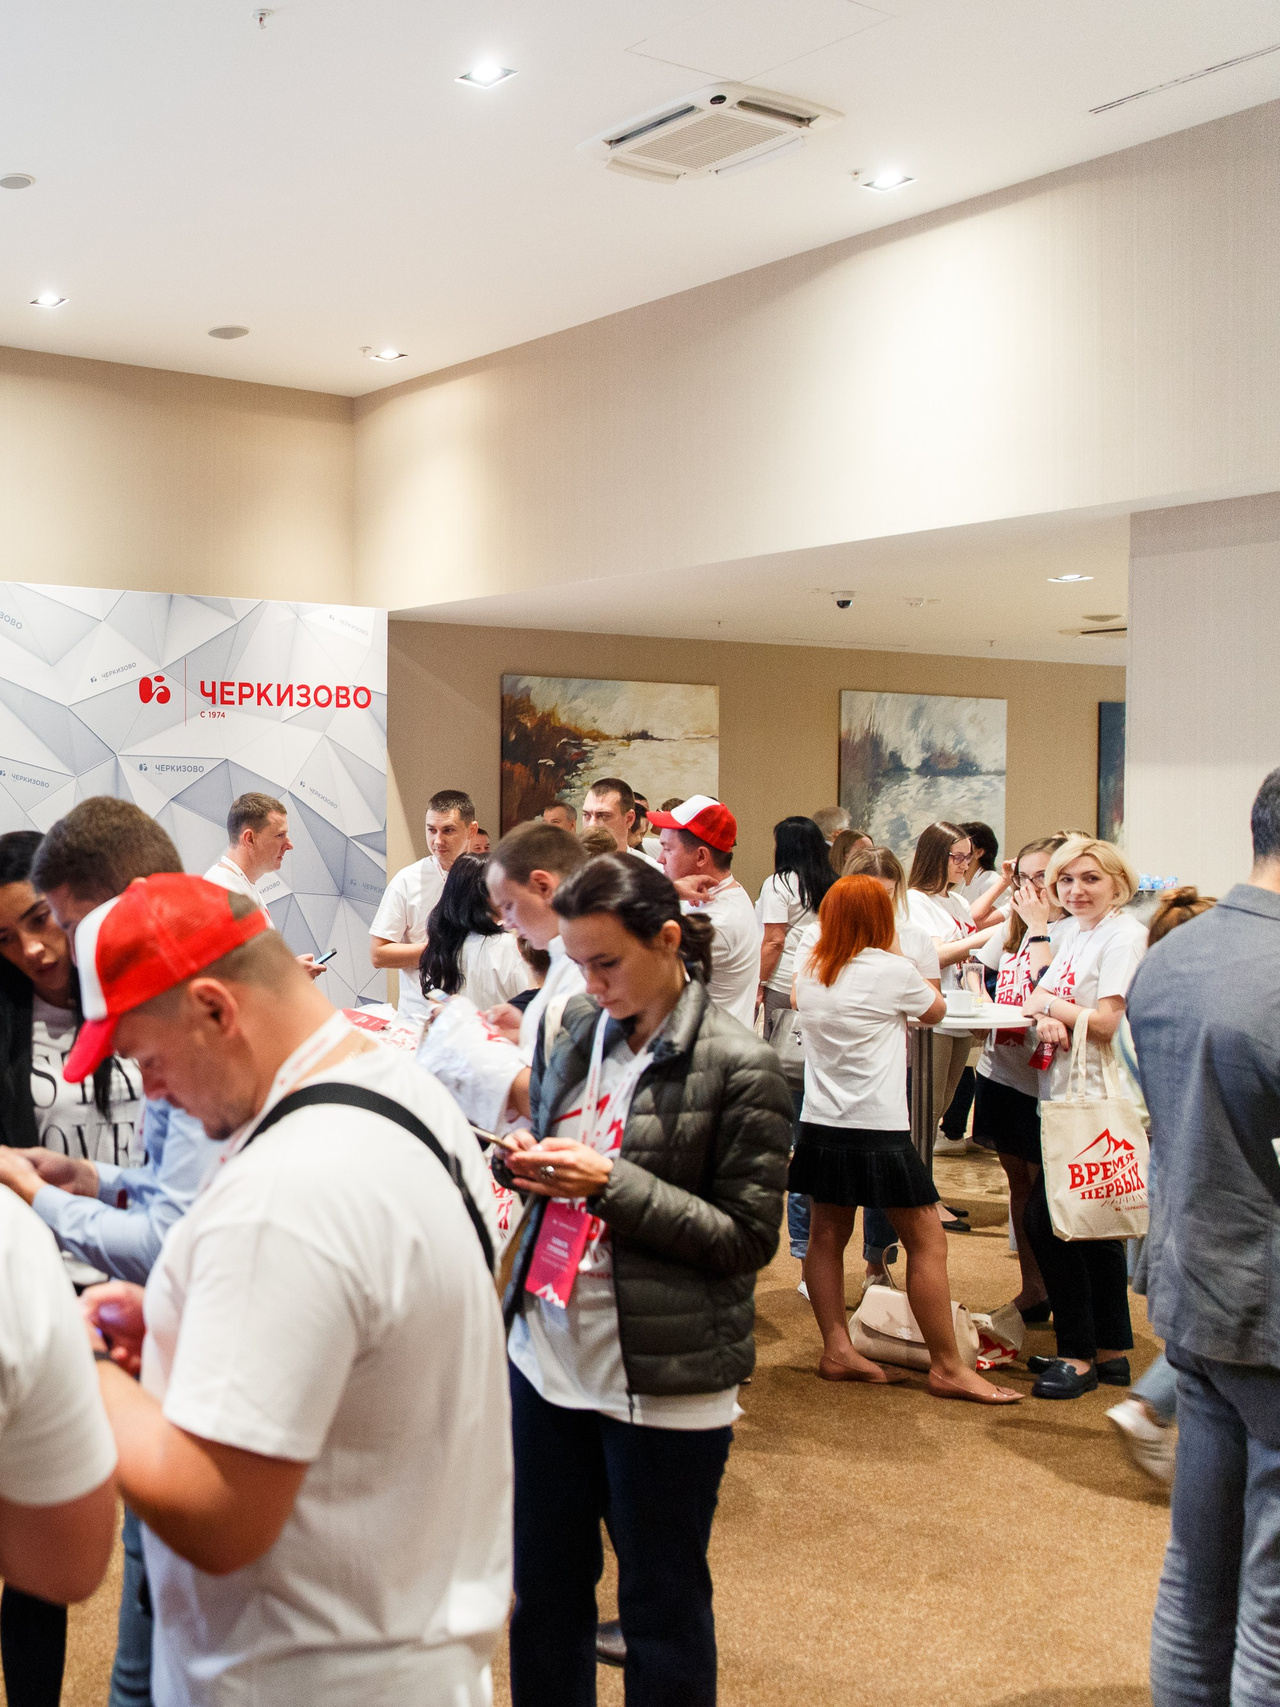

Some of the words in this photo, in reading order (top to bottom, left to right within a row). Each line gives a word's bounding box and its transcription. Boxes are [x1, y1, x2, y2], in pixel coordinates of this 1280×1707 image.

[100, 661, 137, 679] ЧЕРКИЗОВО
[199, 680, 372, 709] ЧЕРКИЗОВО
[208, 711, 226, 719] 1974
[154, 764, 205, 773] ЧЕРКИЗОВО
[11, 773, 51, 789] ЧЕРКИЗОВО
[308, 786, 338, 810] ЧЕРКИЗОВО
[1067, 1151, 1135, 1190] ВРЕМЯ
[1080, 1161, 1146, 1200] ПЕРВЫХ
